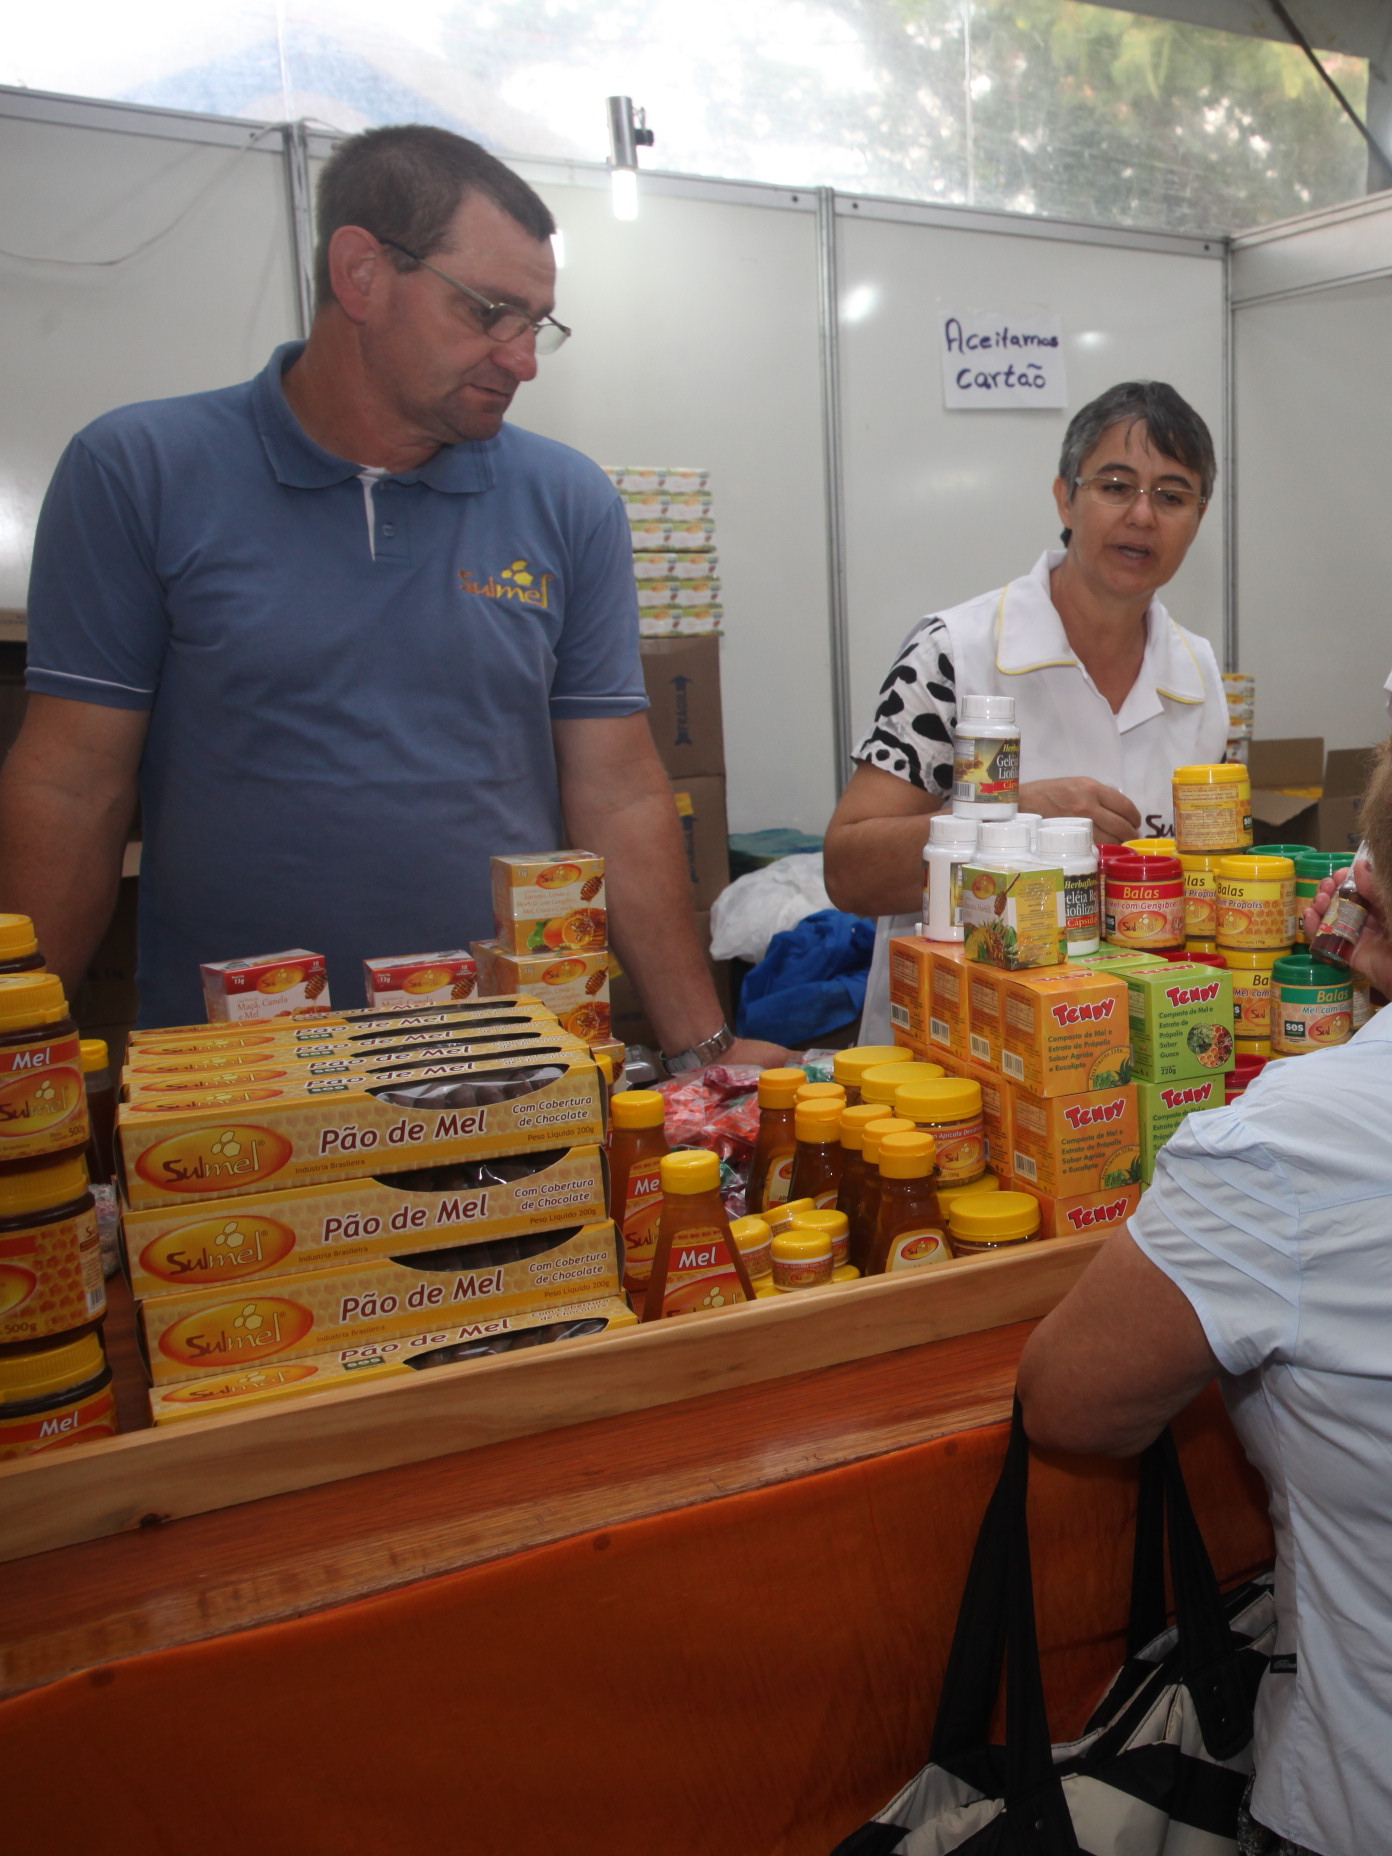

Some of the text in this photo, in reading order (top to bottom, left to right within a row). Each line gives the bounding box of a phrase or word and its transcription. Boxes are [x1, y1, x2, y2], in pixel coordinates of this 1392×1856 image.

[945, 318, 1059, 354] Aceitamos
[956, 363, 1046, 389] Cartão
[1145, 814, 1175, 838] Su
[1066, 890, 1088, 905] eléia
[1123, 887, 1159, 899] Balas
[1189, 890, 1216, 898] Propol
[1140, 901, 1177, 911] Gengibre
[1234, 989, 1249, 997] Mel
[1317, 990, 1349, 1003] Balas
[1159, 1010, 1189, 1020] Composto
[1198, 1006, 1208, 1014] Mel
[1302, 1005, 1318, 1014] Mel
[361, 1020, 390, 1030] de
[400, 1014, 447, 1026] Mel
[1159, 1021, 1179, 1029] Extrato
[360, 1037, 393, 1047] de
[404, 1031, 453, 1042] Mel
[1048, 1034, 1085, 1044] Composto
[1048, 1042, 1071, 1052] Extrato
[1160, 1041, 1177, 1049] Sabor
[12, 1047, 51, 1071] Mel
[308, 1045, 471, 1070] Pão de Mel
[1048, 1053, 1069, 1063] Sabor
[1160, 1050, 1179, 1059] Guaco
[1055, 1060, 1086, 1072] Eucalipto
[1161, 1067, 1176, 1075] 220g
[305, 1062, 475, 1088] Pão de Mel
[513, 1096, 592, 1114] Com Cobertura
[519, 1108, 588, 1127] de Chocolate
[319, 1109, 486, 1154] Pão de Mel
[527, 1132, 545, 1142] Peso
[577, 1125, 594, 1136] 200g
[1153, 1122, 1174, 1131] Extrato
[1061, 1134, 1095, 1145] Composto
[1106, 1130, 1118, 1138] Mel
[1061, 1145, 1085, 1155] Extrato
[162, 1139, 260, 1184] Sulmel
[330, 1159, 366, 1170] Brasileira
[1062, 1156, 1082, 1165] Sabor
[1069, 1163, 1098, 1174] Eucalipto
[515, 1178, 594, 1199] Com Cobertura
[635, 1177, 659, 1196] Me
[521, 1191, 590, 1210] de Chocolate
[323, 1194, 488, 1242] Pão de Mel
[529, 1215, 547, 1225] Peso
[579, 1208, 596, 1219] 200g
[625, 1231, 656, 1250] Sul
[166, 1230, 263, 1275] Sulmel
[334, 1245, 369, 1257] Brasileira
[678, 1247, 716, 1269] Mel
[529, 1252, 608, 1273] Com Cobertura
[536, 1265, 604, 1285] de Chocolate
[340, 1269, 504, 1322] Pão de Mel
[544, 1288, 562, 1299] Peso
[592, 1280, 610, 1290] 200g
[4, 1322, 37, 1335] 500g
[185, 1312, 281, 1358] Sulmel
[351, 1323, 386, 1337] Brasileira
[340, 1319, 510, 1362] Pão de Mel
[39, 1411, 79, 1438] Mel
